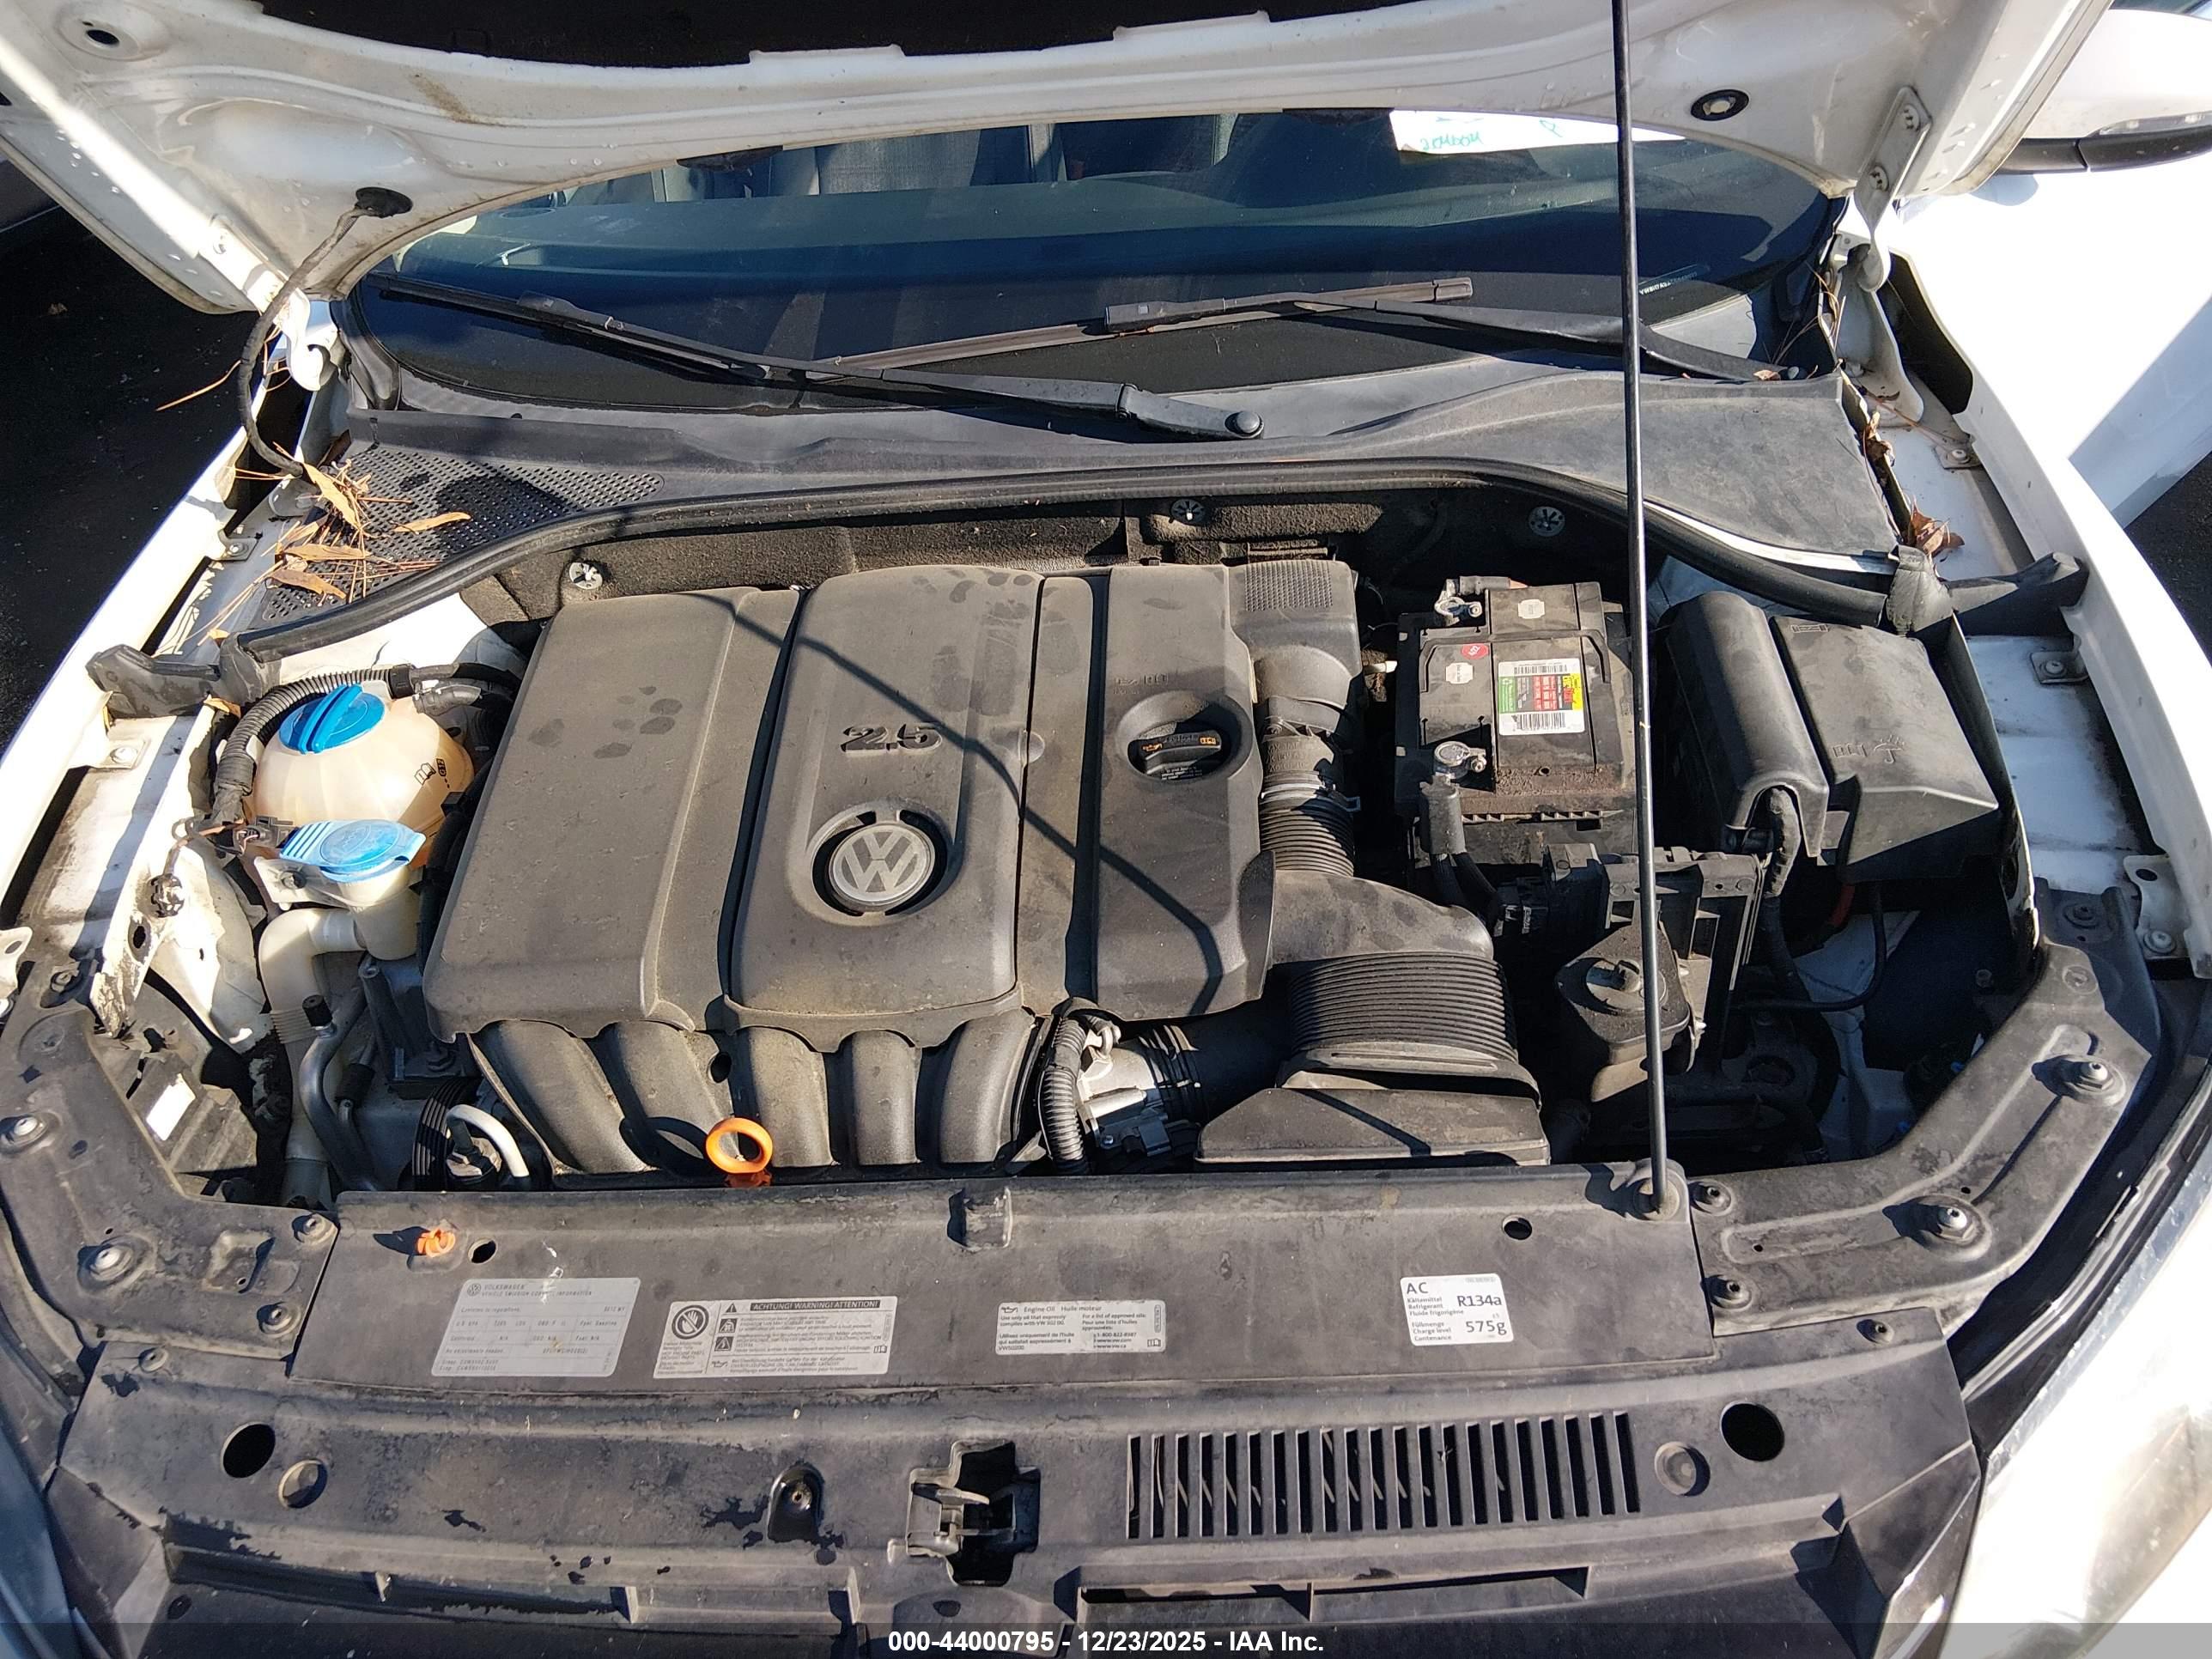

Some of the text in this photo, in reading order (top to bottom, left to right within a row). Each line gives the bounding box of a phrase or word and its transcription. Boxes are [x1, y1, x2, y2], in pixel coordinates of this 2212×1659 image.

[841, 724, 942, 752] 2.5
[835, 1300, 878, 1309] ATTENTION!
[1456, 1295, 1502, 1306] R134a
